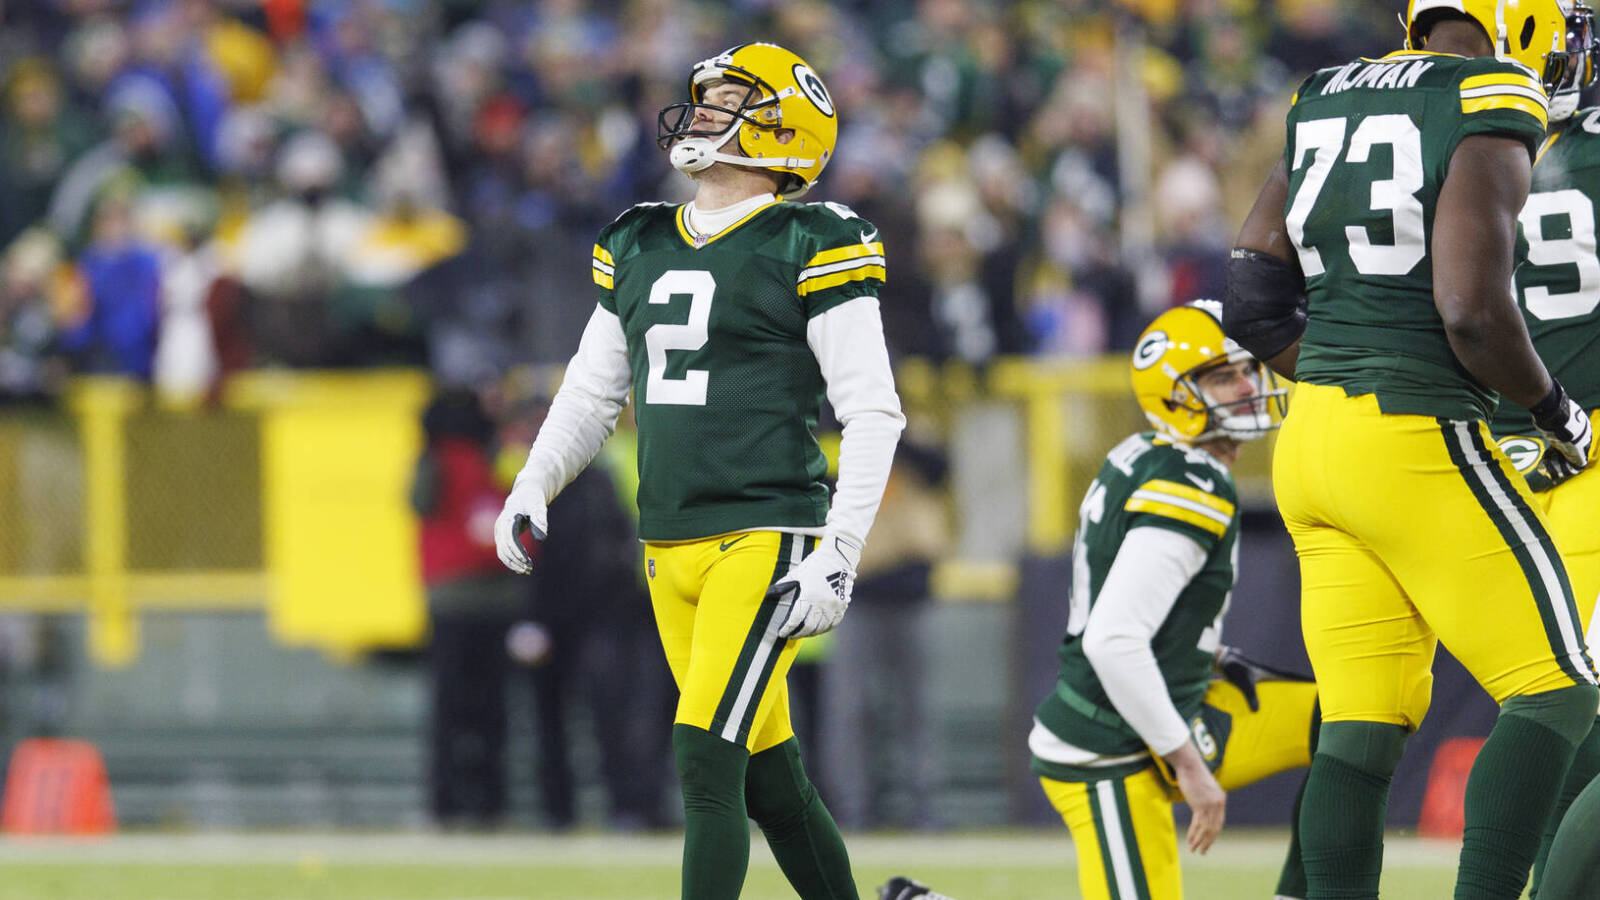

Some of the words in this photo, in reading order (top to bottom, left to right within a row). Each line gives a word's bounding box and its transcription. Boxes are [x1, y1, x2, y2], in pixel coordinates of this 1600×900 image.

[1320, 60, 1435, 96] NIJMAN
[1285, 113, 1426, 278] 73
[645, 269, 717, 406] 2
[1133, 330, 1168, 370] G
